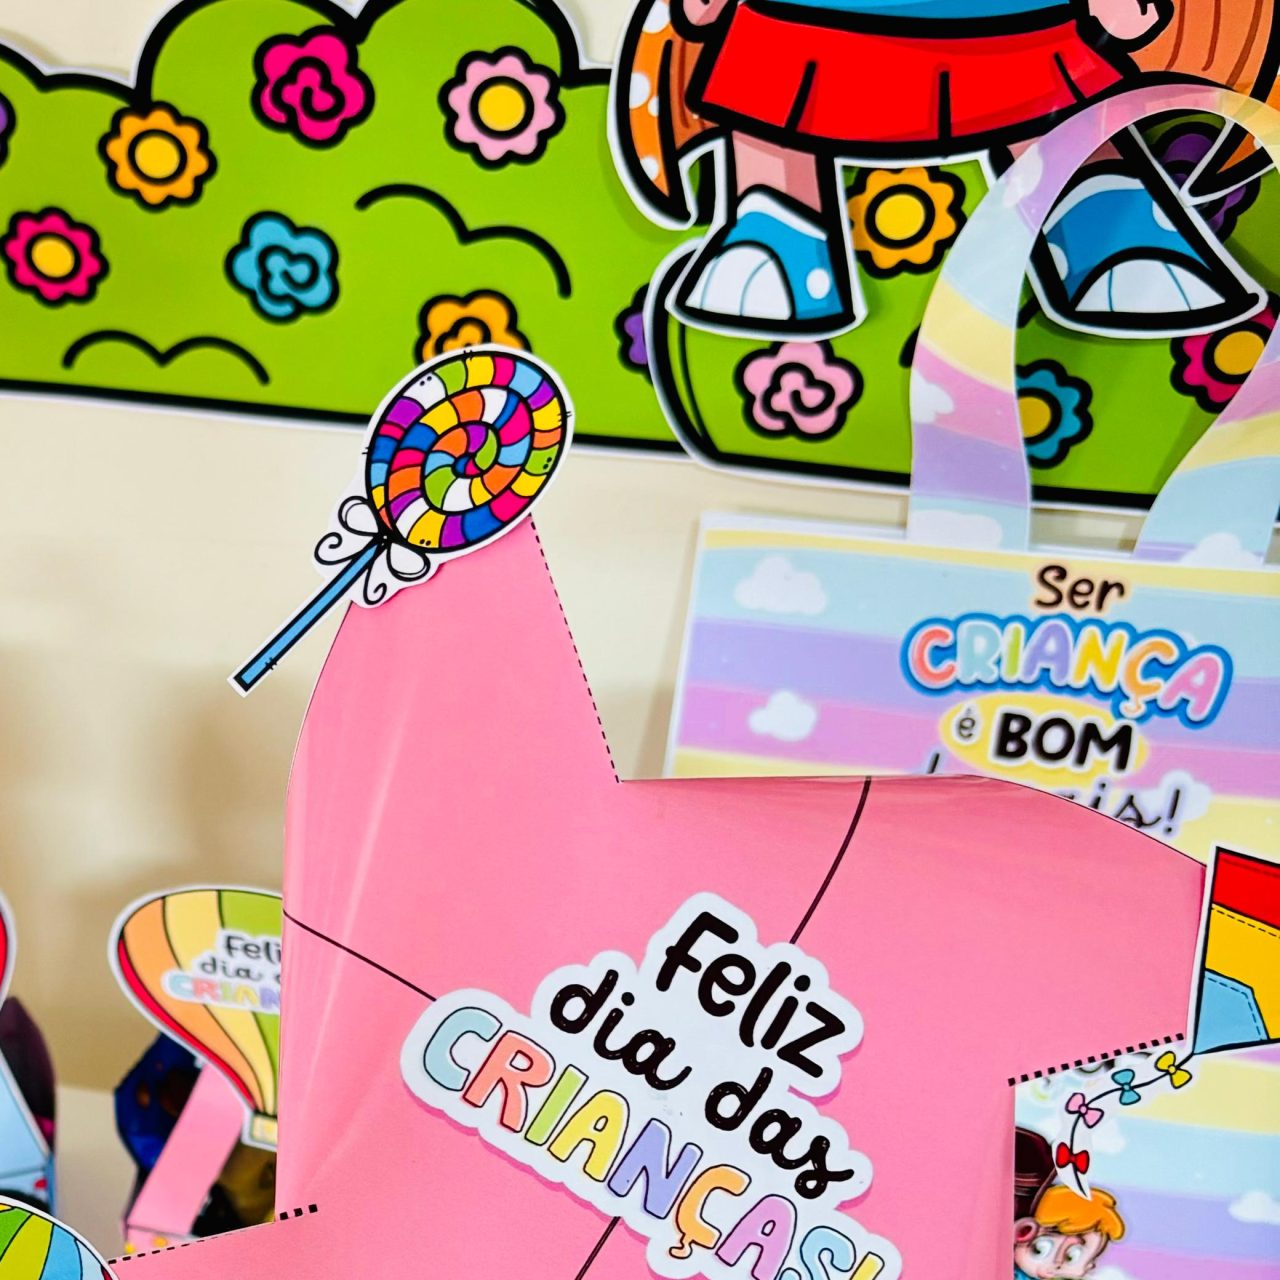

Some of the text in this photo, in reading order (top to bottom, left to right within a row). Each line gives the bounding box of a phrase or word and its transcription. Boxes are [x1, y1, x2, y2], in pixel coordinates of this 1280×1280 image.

[1034, 564, 1125, 612] Ser
[911, 620, 1221, 720] CRIANÇA
[994, 712, 1134, 772] BOM
[200, 956, 263, 982] dia
[655, 911, 846, 1078] Feliz
[550, 969, 855, 1199] dia das
